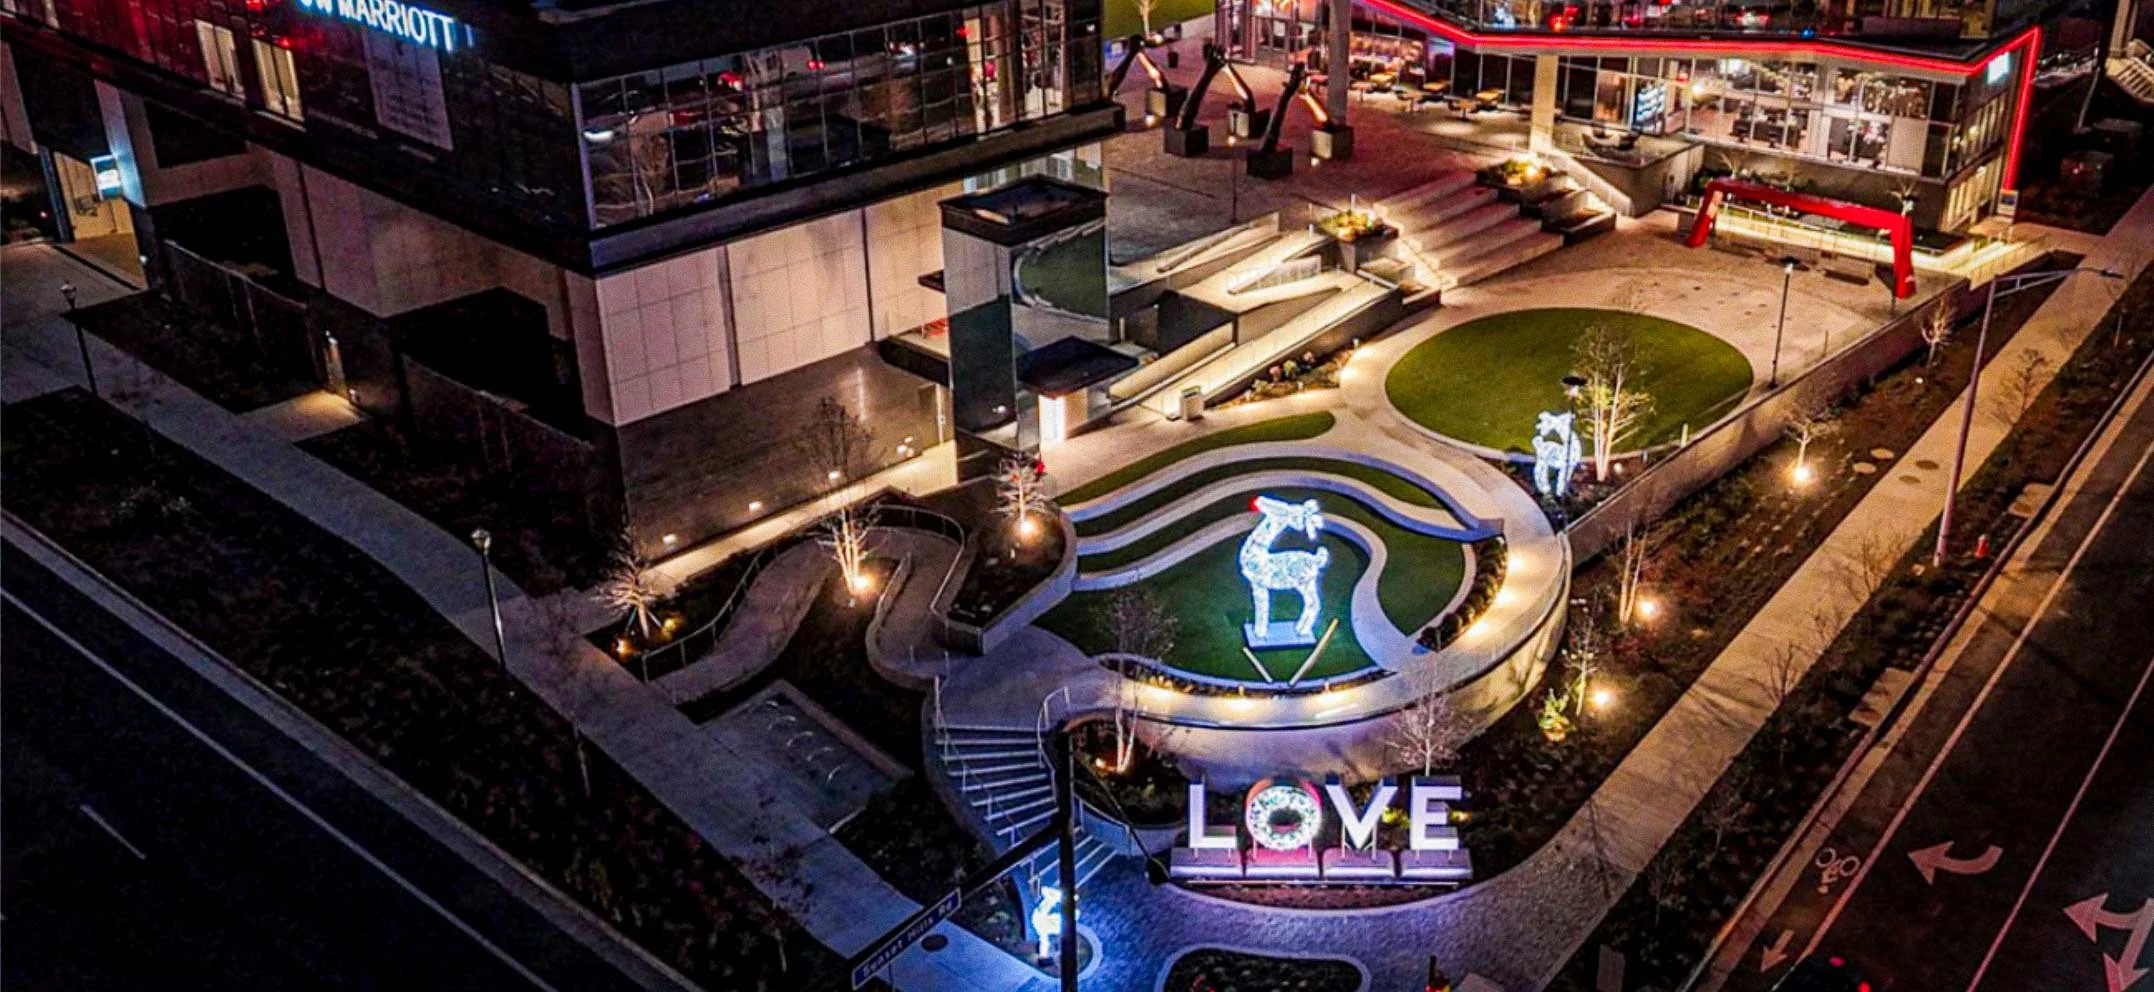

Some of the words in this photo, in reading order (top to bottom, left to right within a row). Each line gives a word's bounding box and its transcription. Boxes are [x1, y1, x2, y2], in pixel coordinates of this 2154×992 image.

[336, 0, 455, 53] MARRIOTT
[1188, 778, 1462, 850] LOVE
[862, 938, 904, 978] Sunset
[906, 916, 934, 942] Hills
[937, 899, 953, 917] Rd
